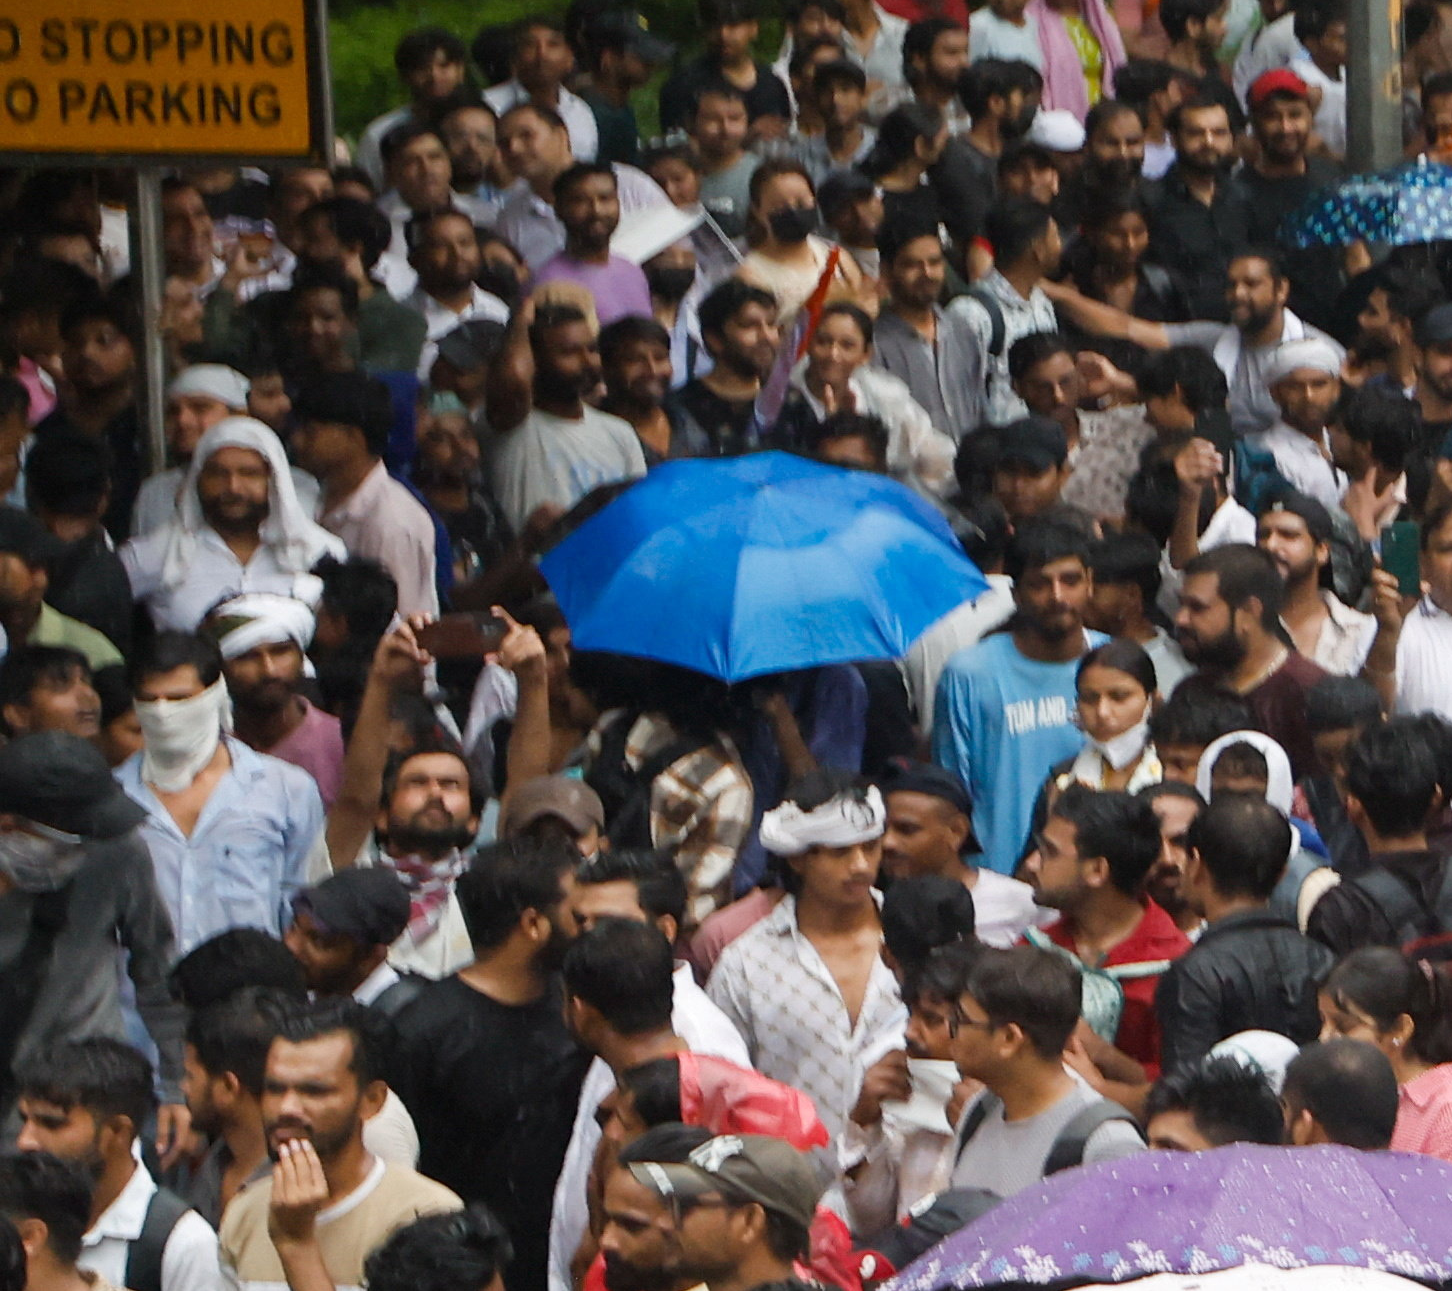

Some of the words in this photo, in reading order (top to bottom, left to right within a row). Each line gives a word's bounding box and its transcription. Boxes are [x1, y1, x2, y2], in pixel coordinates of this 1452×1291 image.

[0, 18, 20, 61] O
[40, 17, 294, 66] STOPPING
[58, 78, 282, 126] PARKING
